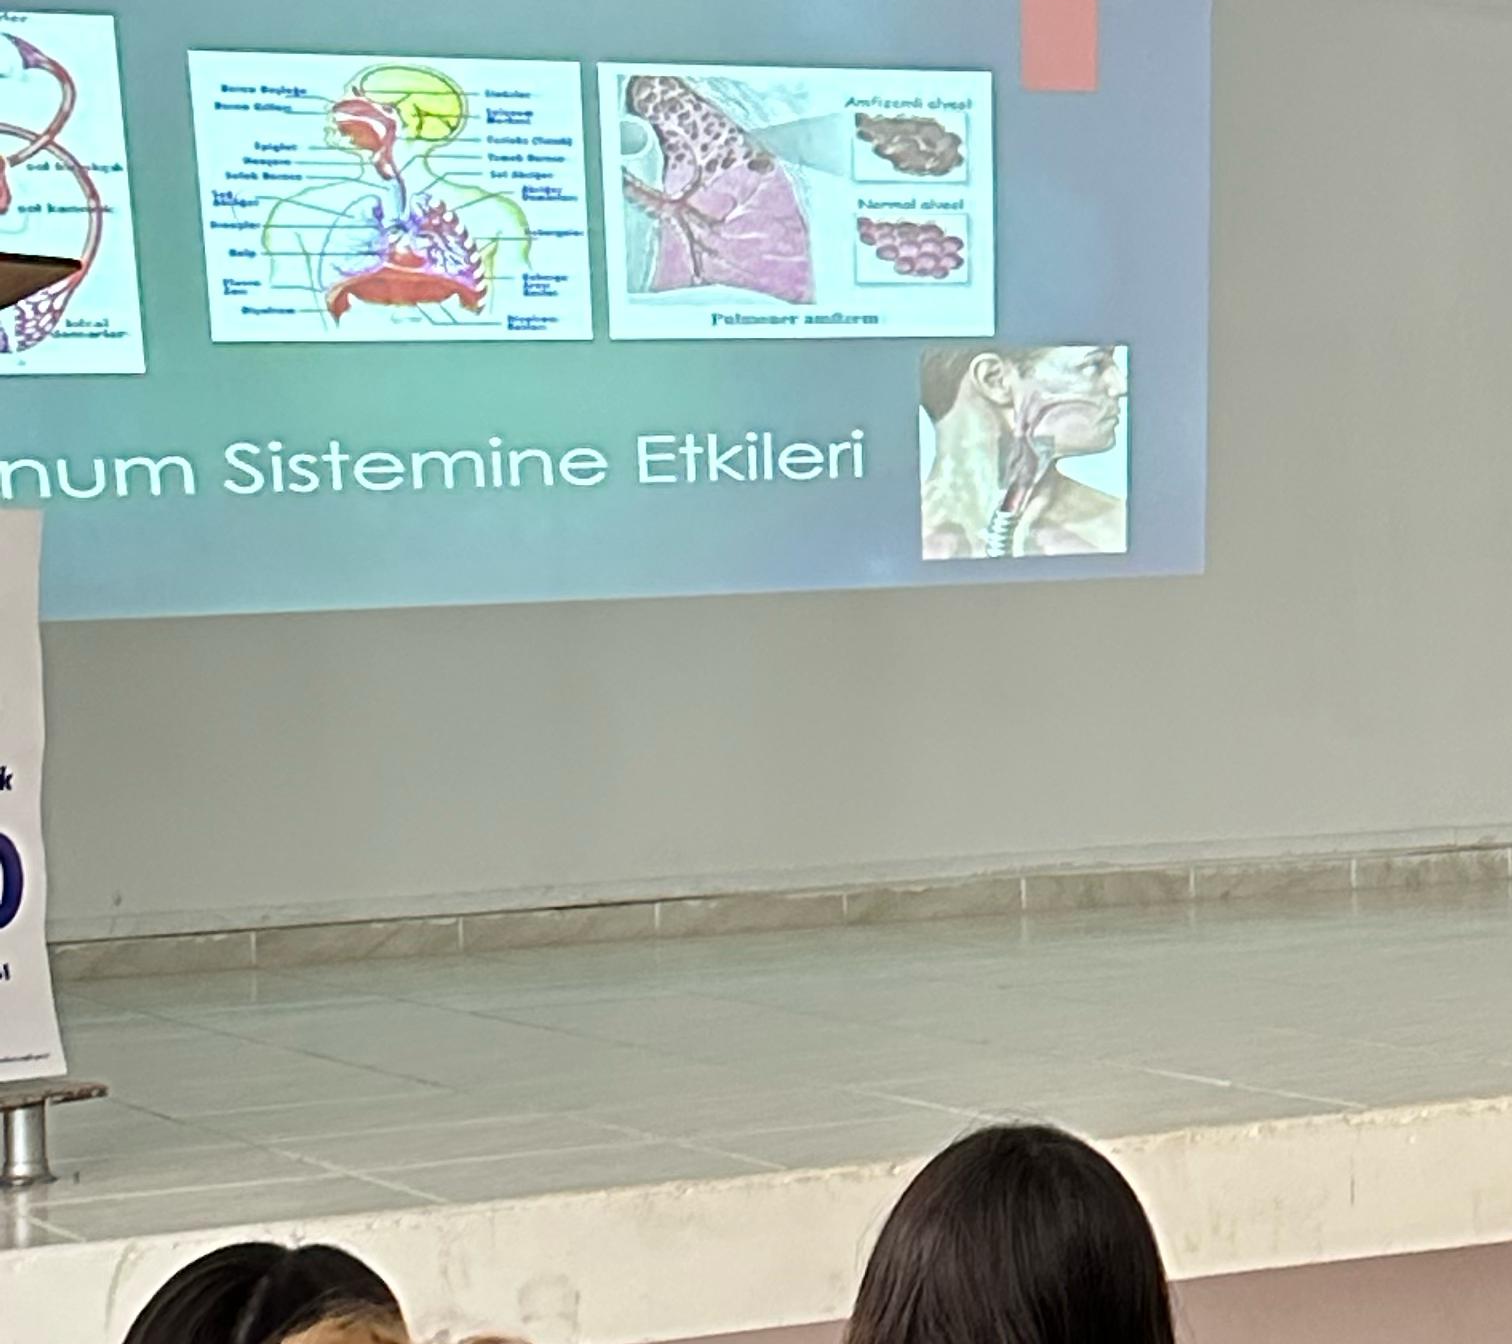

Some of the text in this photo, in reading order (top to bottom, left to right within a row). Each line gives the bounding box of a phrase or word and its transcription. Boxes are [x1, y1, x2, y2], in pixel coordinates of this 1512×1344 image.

[857, 198, 917, 209] Normal
[0, 428, 865, 500] num Sistemine Etkileri
